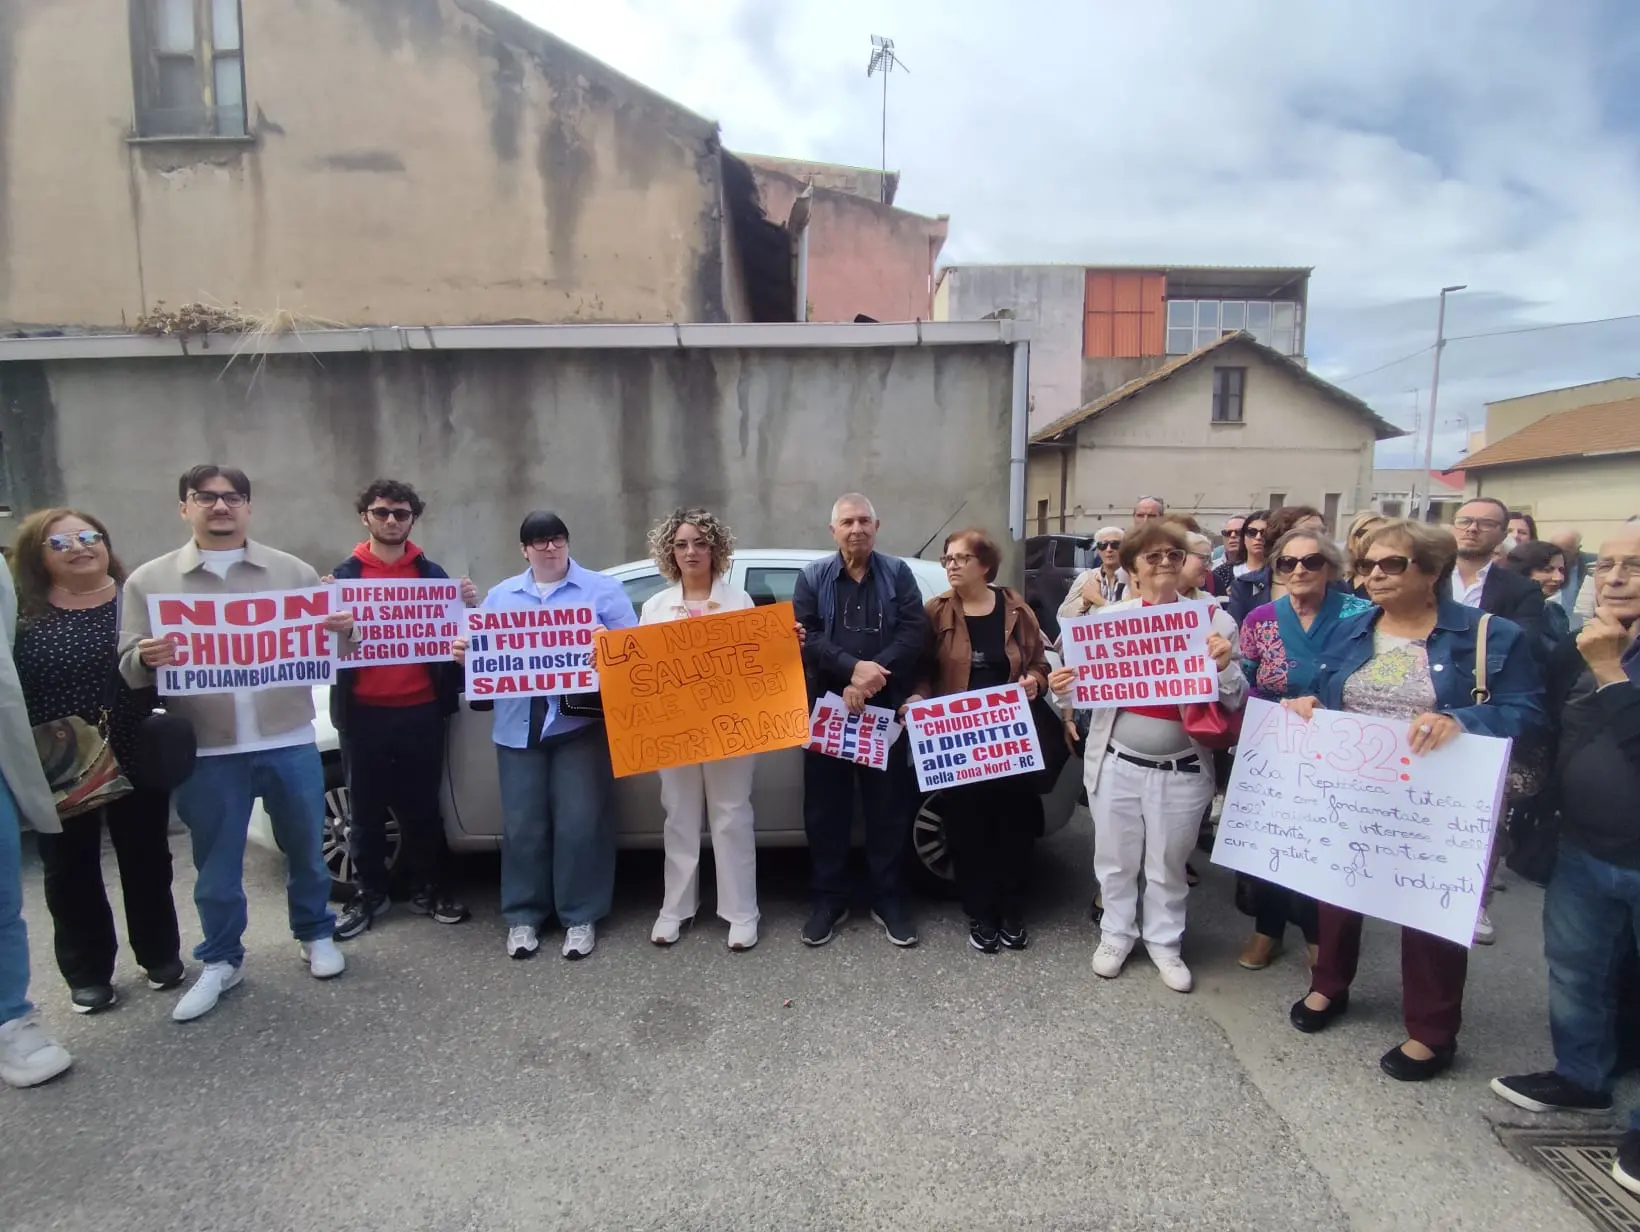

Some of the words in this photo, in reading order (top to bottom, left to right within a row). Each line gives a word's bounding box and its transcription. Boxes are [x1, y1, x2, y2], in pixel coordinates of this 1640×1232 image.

[342, 585, 457, 602] DIFENDIAMO
[158, 591, 329, 626] NON
[352, 606, 375, 622] LA
[379, 604, 449, 621] SANITA'
[468, 608, 593, 631] SALVIAMO
[441, 622, 458, 637] di
[471, 635, 489, 652] il
[496, 629, 593, 650] FUTURO
[600, 634, 648, 667] LA
[662, 611, 790, 654] NOSTRA
[1072, 611, 1199, 642] DIFENDIAMO
[163, 622, 331, 666] CHIUDETE
[340, 643, 410, 661] EGGIO
[414, 641, 453, 657] NOR
[1085, 645, 1109, 660] LA
[1112, 634, 1191, 658] SANITA'
[166, 671, 181, 690] IL
[185, 660, 331, 689] POLIAMBULATORIO
[472, 655, 524, 673] della
[529, 652, 590, 669] nostra
[629, 643, 763, 697] SALUTE
[1078, 657, 1179, 681] PUBBLICA
[1184, 656, 1205, 673] di
[473, 671, 593, 695] SALUTE
[1077, 682, 1149, 702] REGGIO
[1155, 677, 1213, 698] NORD
[611, 693, 684, 730] VALE
[911, 690, 1019, 721] NON
[876, 717, 890, 731] RC
[915, 706, 1021, 737] "CHIUDETECI"
[918, 739, 934, 755] il
[938, 722, 1028, 751] DIRITTO
[922, 753, 967, 771] alle
[972, 738, 1032, 762] CURE
[925, 772, 955, 786] nella
[956, 766, 983, 780] zona
[984, 760, 1012, 775] Nord
[1019, 755, 1035, 769] RC
